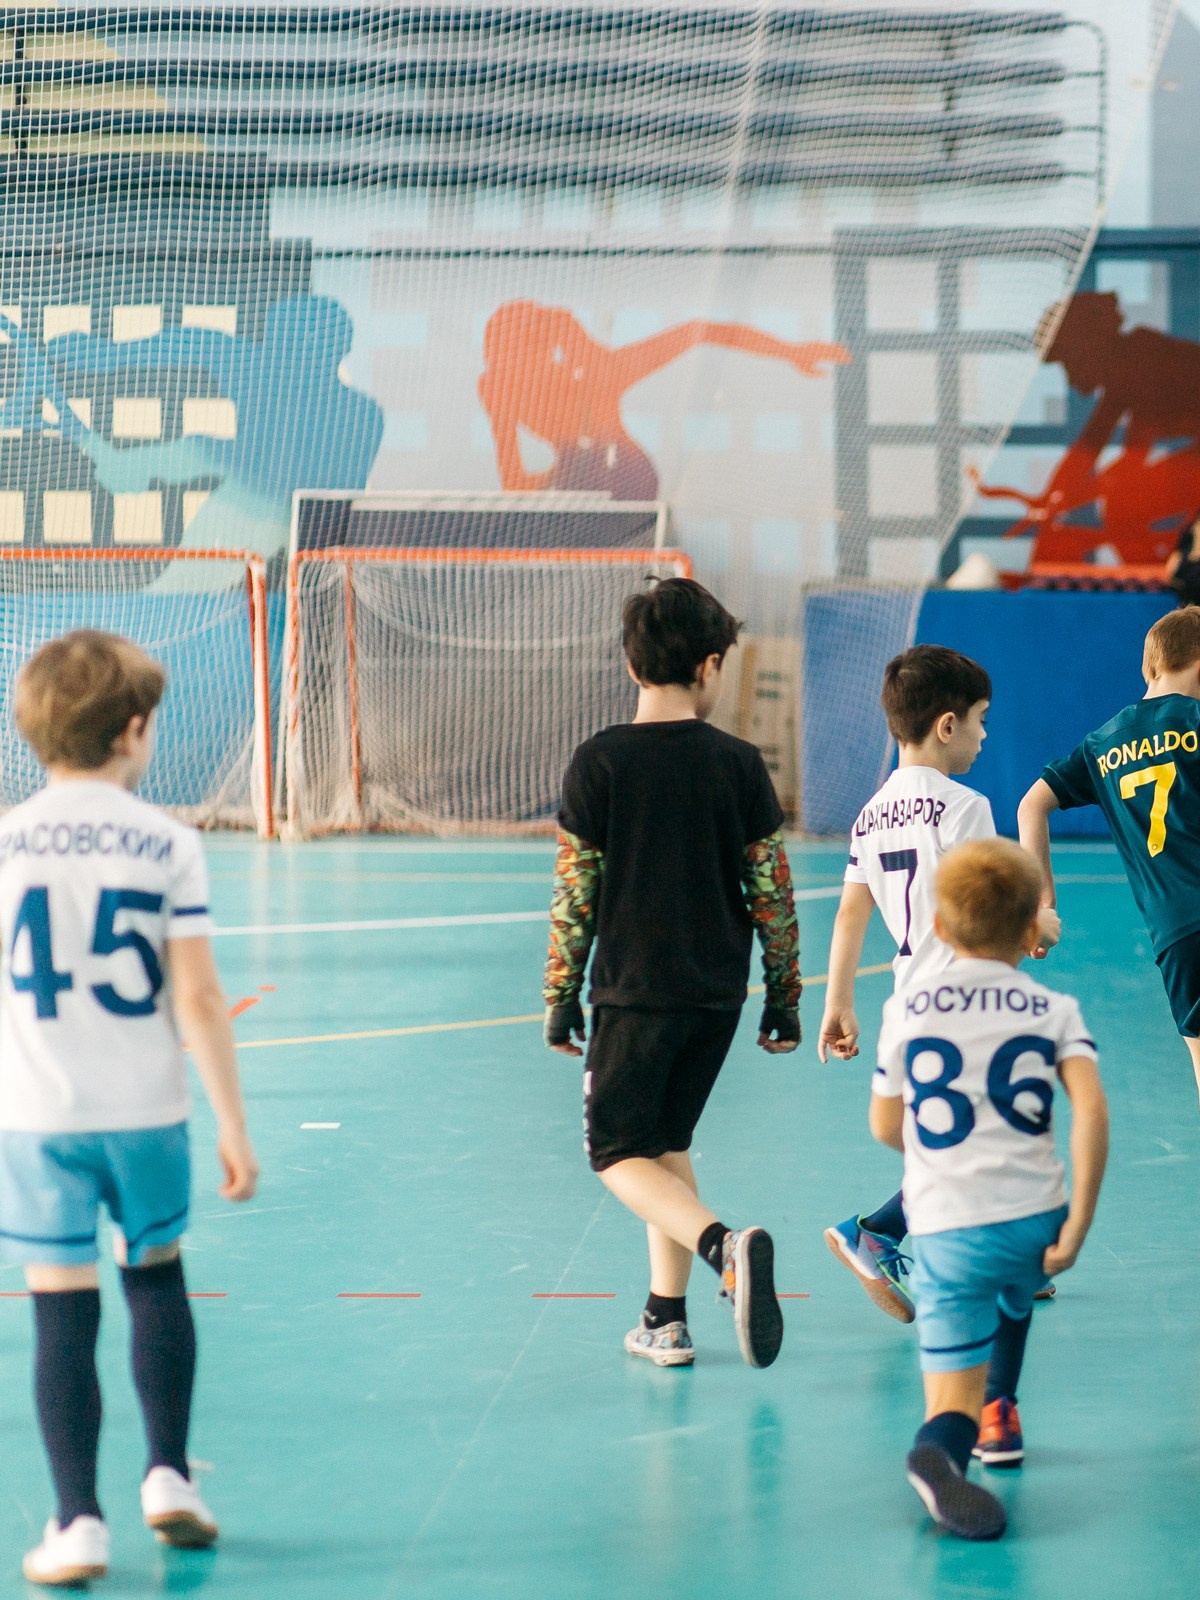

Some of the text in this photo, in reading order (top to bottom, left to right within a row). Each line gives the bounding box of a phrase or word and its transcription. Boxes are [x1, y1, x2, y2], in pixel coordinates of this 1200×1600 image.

[1097, 730, 1198, 778] RONALDO
[1119, 761, 1177, 858] 7
[10, 884, 164, 1020] 45
[878, 848, 919, 957] 7
[905, 985, 1049, 1017] ЮСУПОВ
[904, 1034, 1056, 1151] 86
